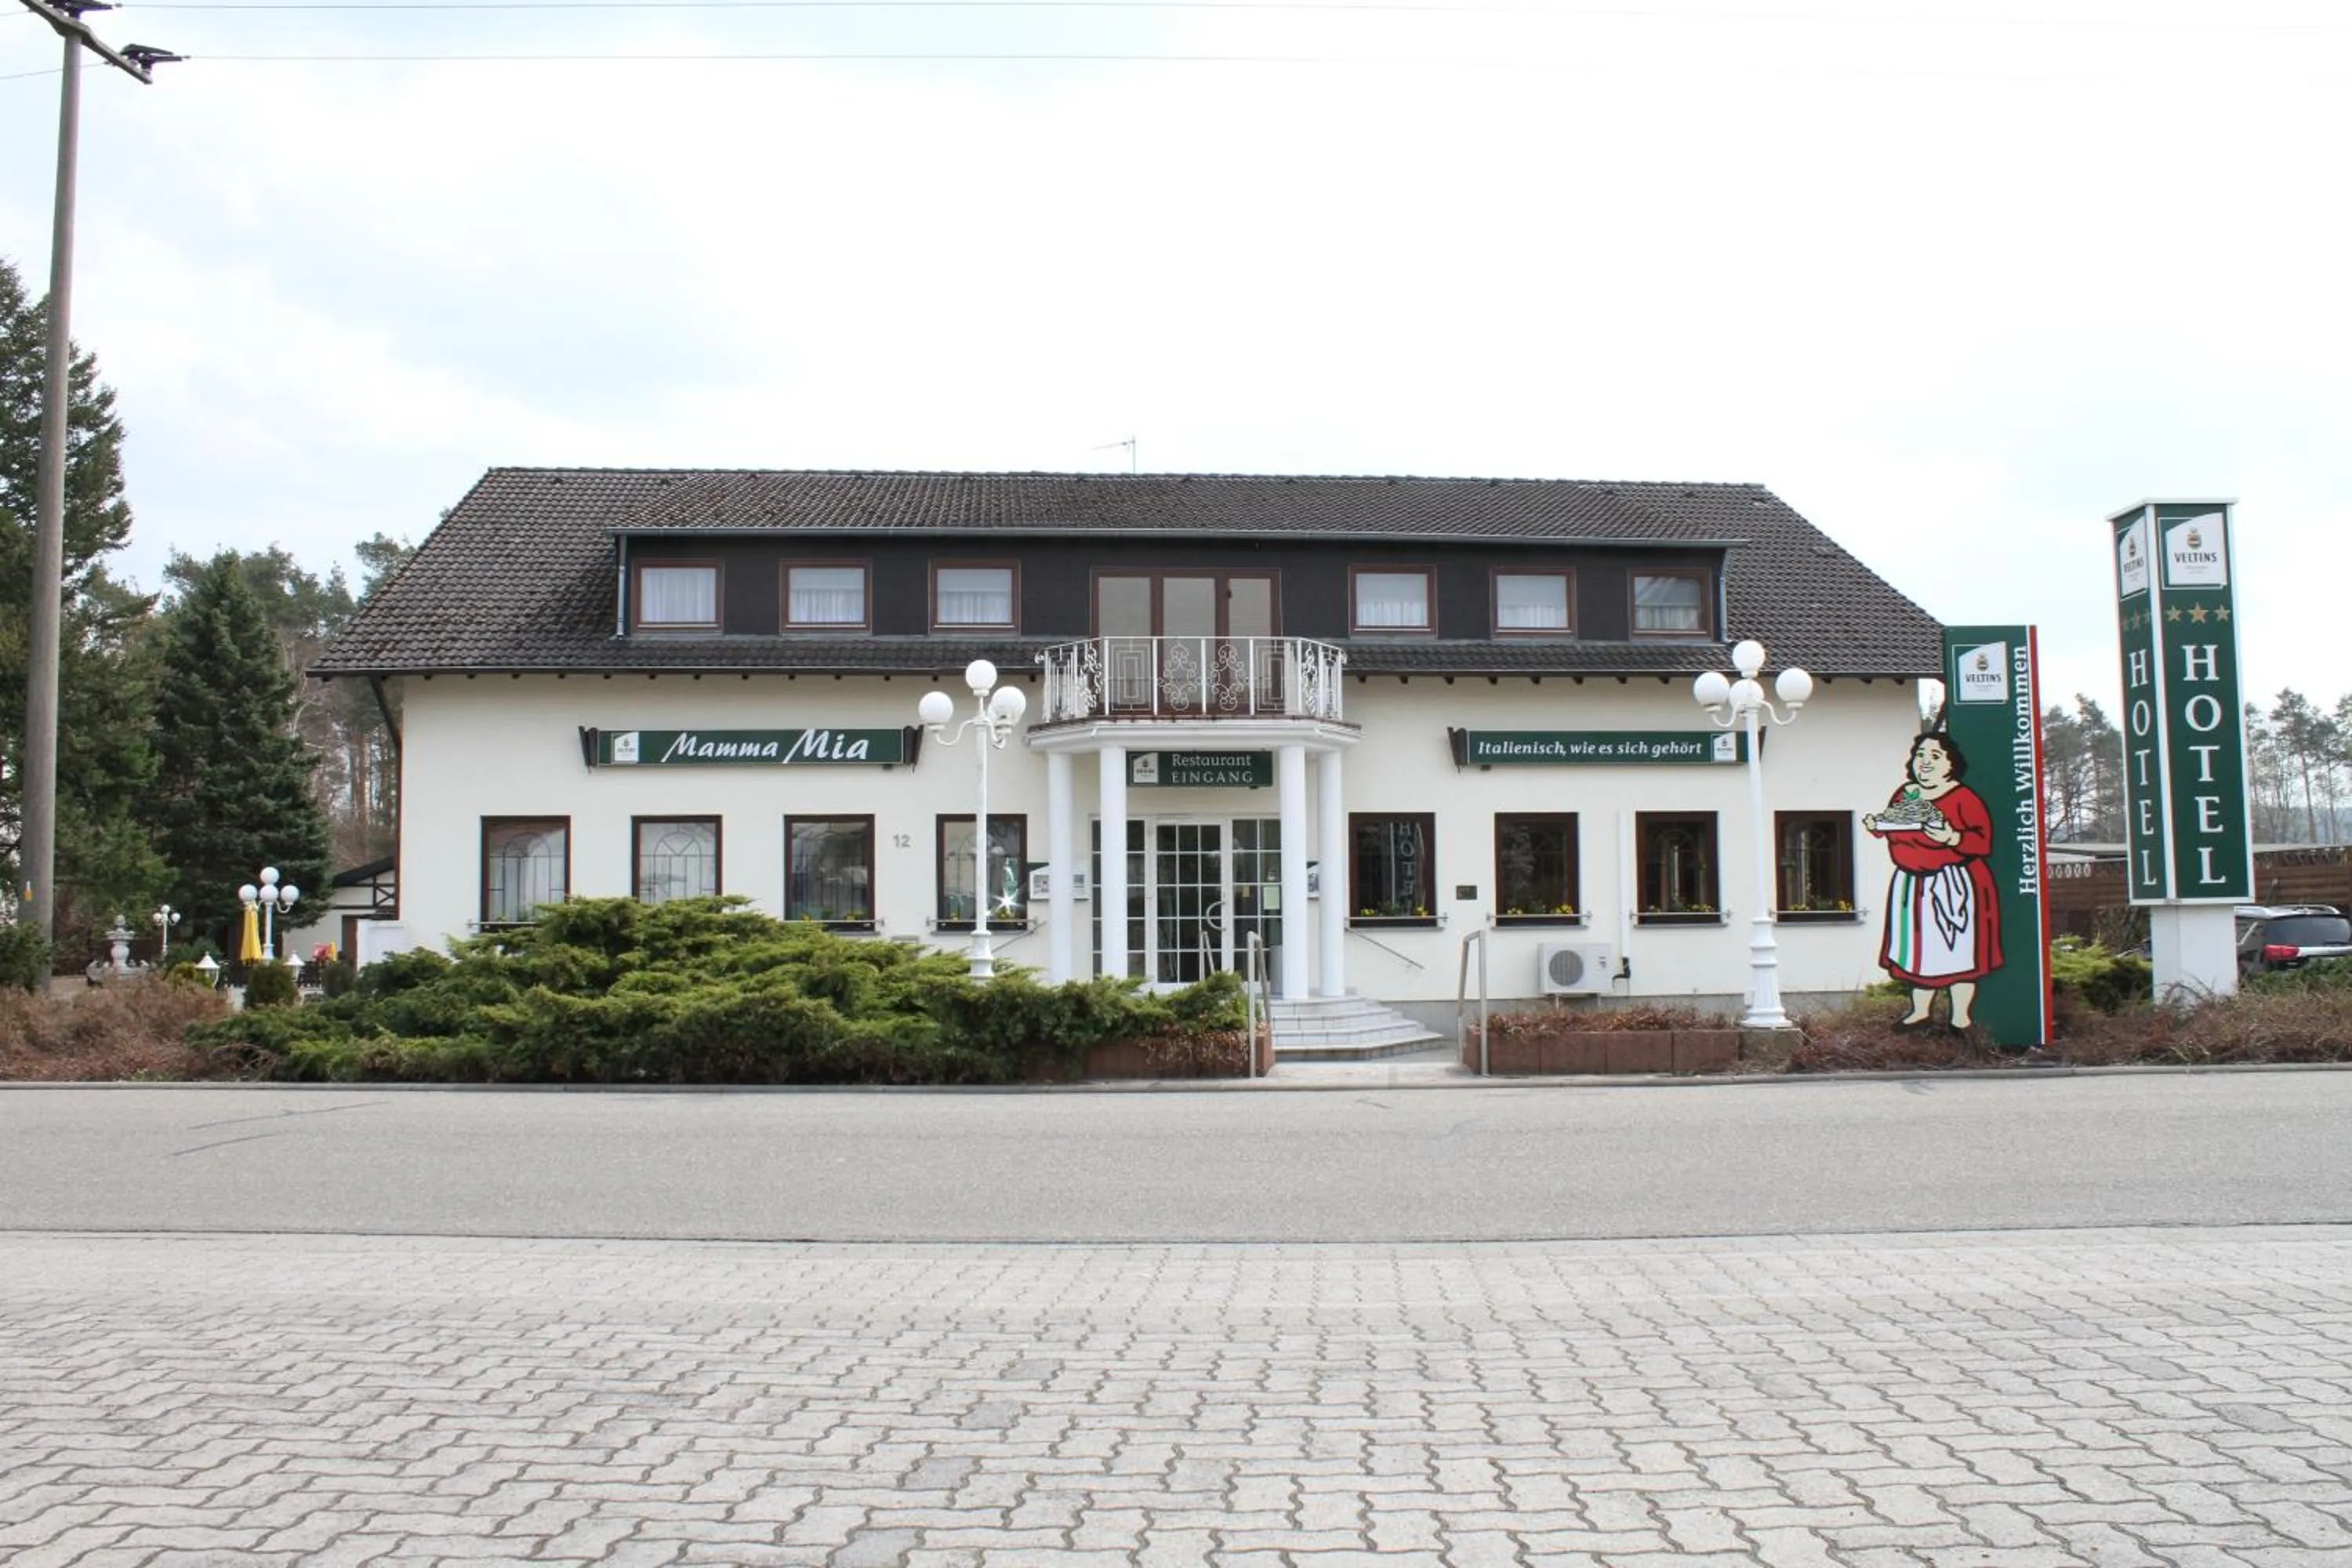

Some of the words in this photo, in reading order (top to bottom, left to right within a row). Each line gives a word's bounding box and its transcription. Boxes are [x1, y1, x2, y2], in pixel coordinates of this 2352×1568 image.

[2174, 552, 2218, 563] VELTINS
[1965, 673, 2002, 683] VELTINS
[2013, 645, 2033, 793] Willkommen
[661, 732, 779, 764] Mamma
[782, 728, 869, 764] Mia
[1479, 741, 1566, 756] Italienisch,
[1570, 741, 1596, 753] wie
[1599, 744, 1613, 753] es
[1617, 741, 1647, 754] sich
[1650, 741, 1702, 758] gehört
[1172, 754, 1253, 766] Restaurant
[2129, 648, 2157, 886] HOTEL
[2181, 644, 2227, 885] HOTEL
[1172, 771, 1254, 783] EINGANG
[892, 834, 911, 848] 12
[2016, 798, 2036, 895] Herzlich
